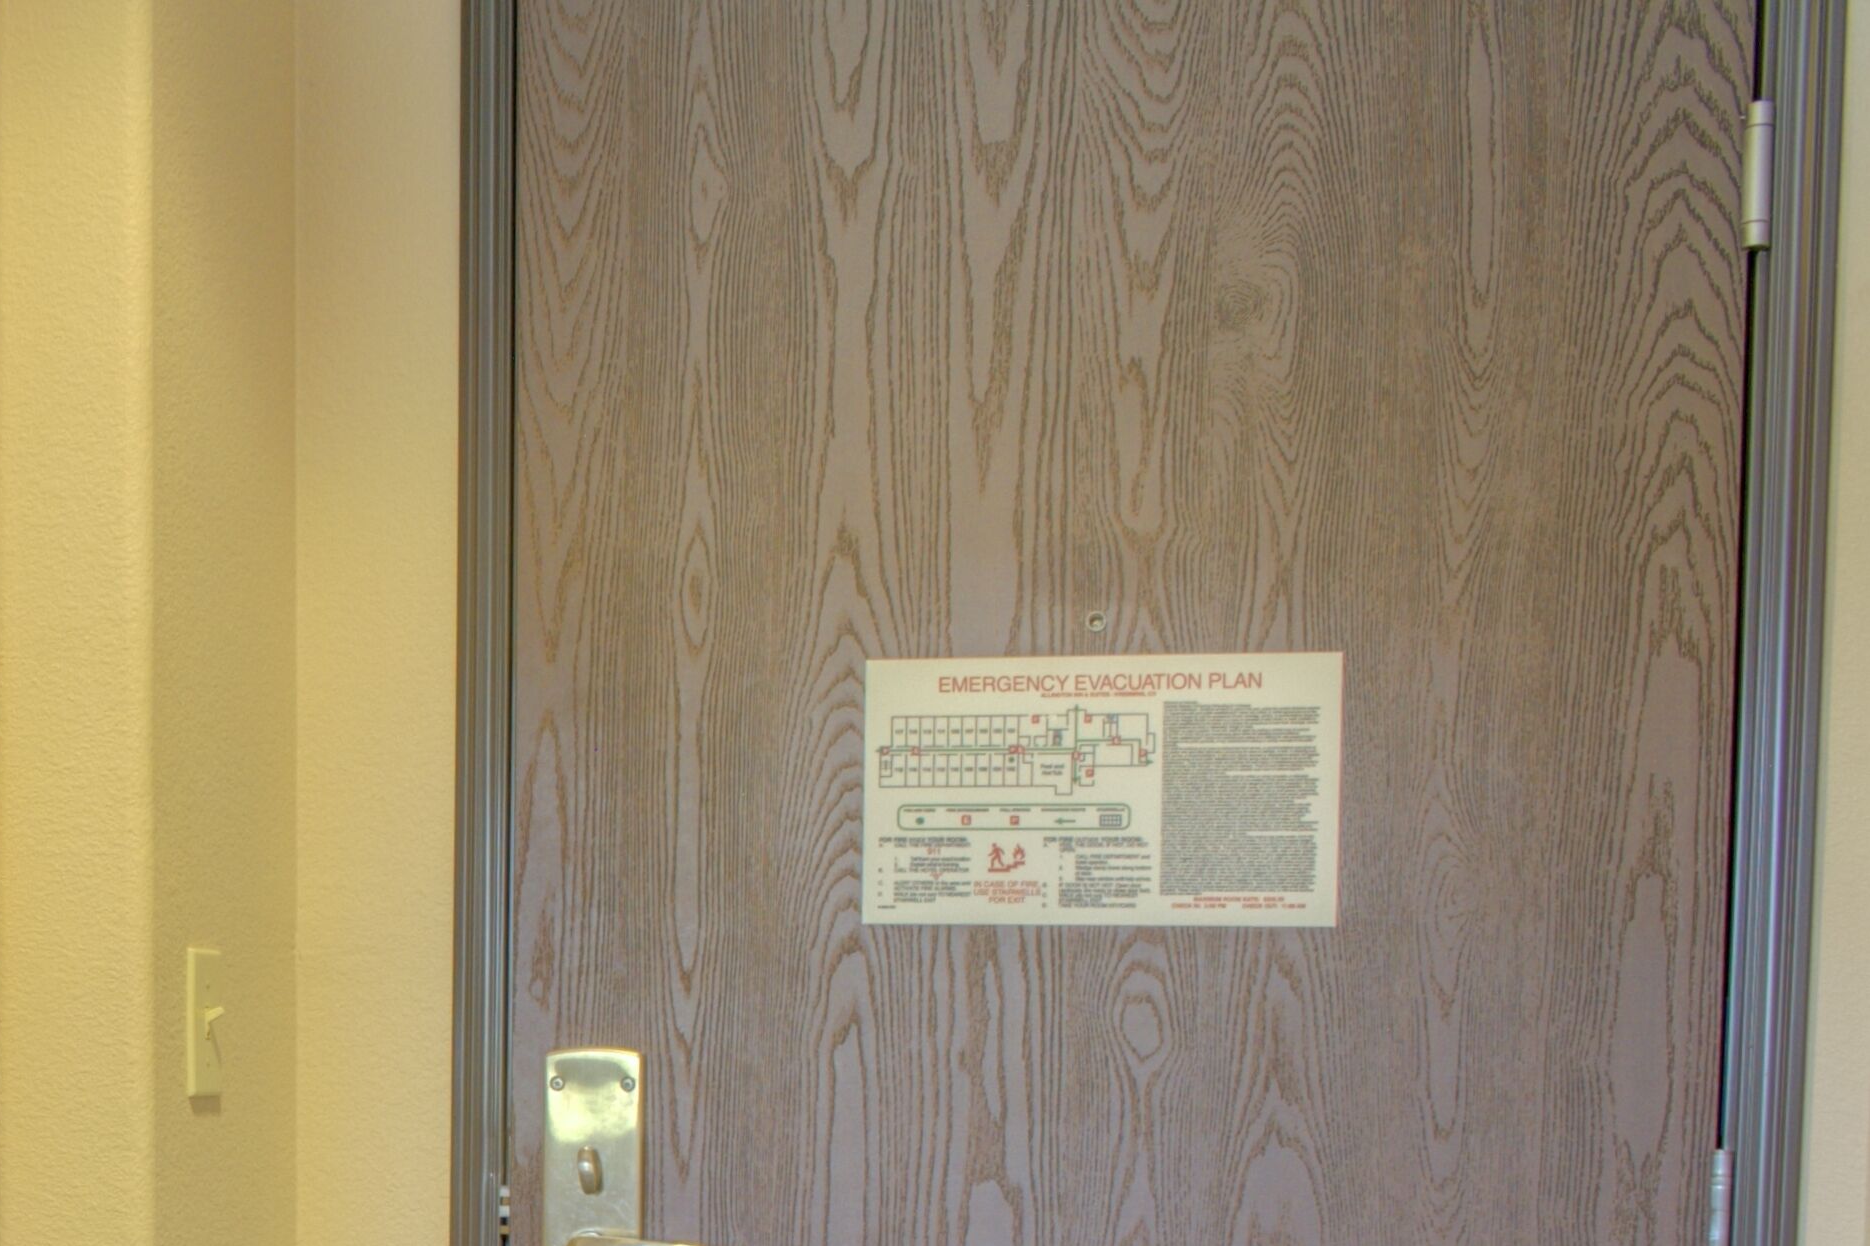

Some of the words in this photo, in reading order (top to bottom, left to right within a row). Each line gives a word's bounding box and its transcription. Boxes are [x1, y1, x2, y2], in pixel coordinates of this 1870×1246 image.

[938, 676, 1069, 694] EMERGENCY
[1074, 673, 1202, 691] EVACUATION
[1208, 672, 1263, 689] PLAN
